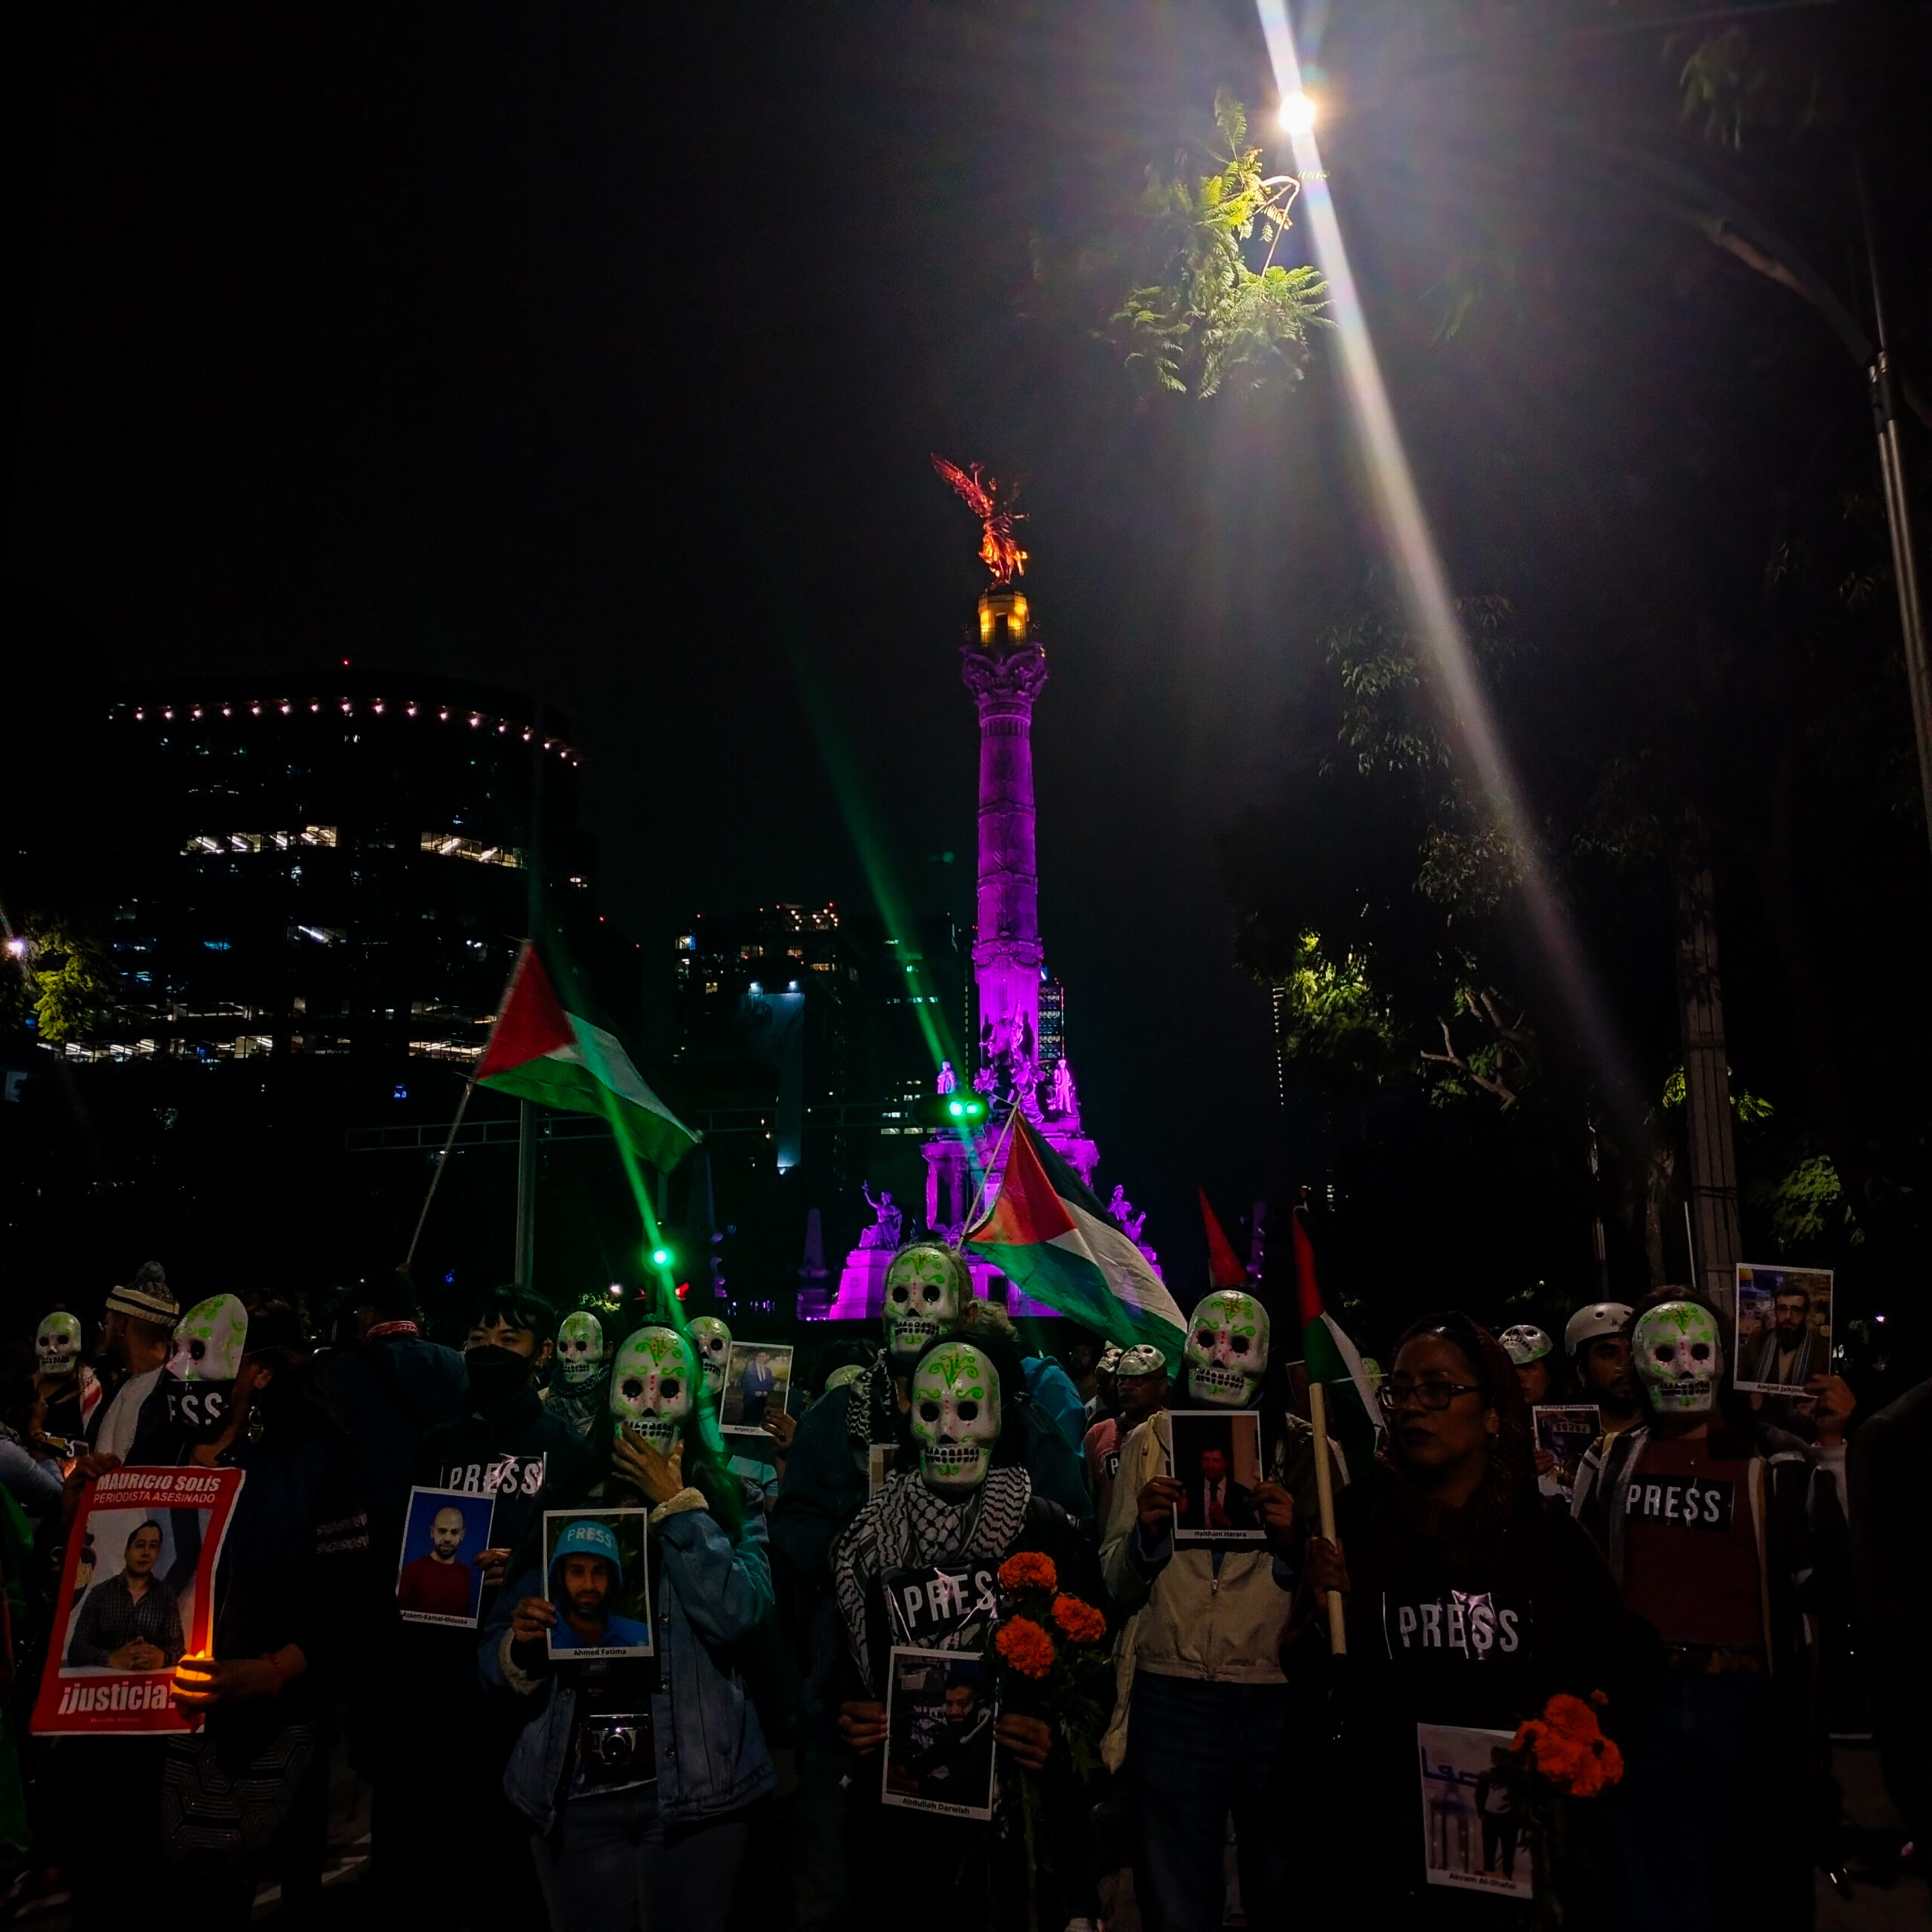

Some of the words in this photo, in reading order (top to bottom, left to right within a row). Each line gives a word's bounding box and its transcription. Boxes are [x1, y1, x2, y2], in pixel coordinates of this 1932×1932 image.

[1555, 1423, 1586, 1432] PRESS
[97, 1472, 174, 1491] MAURICIO
[174, 1475, 222, 1492] SOLÍS
[448, 1463, 540, 1494] PRESS
[94, 1491, 151, 1504] PERIODISTA
[152, 1491, 216, 1504] ASESINADO
[1626, 1484, 1721, 1523] PRESS
[568, 1527, 612, 1549] PRESS
[1398, 1603, 1519, 1653] PRESS
[903, 1798, 937, 1810] Abdullah
[938, 1803, 971, 1814] Darwish
[1449, 1873, 1477, 1882] Akram
